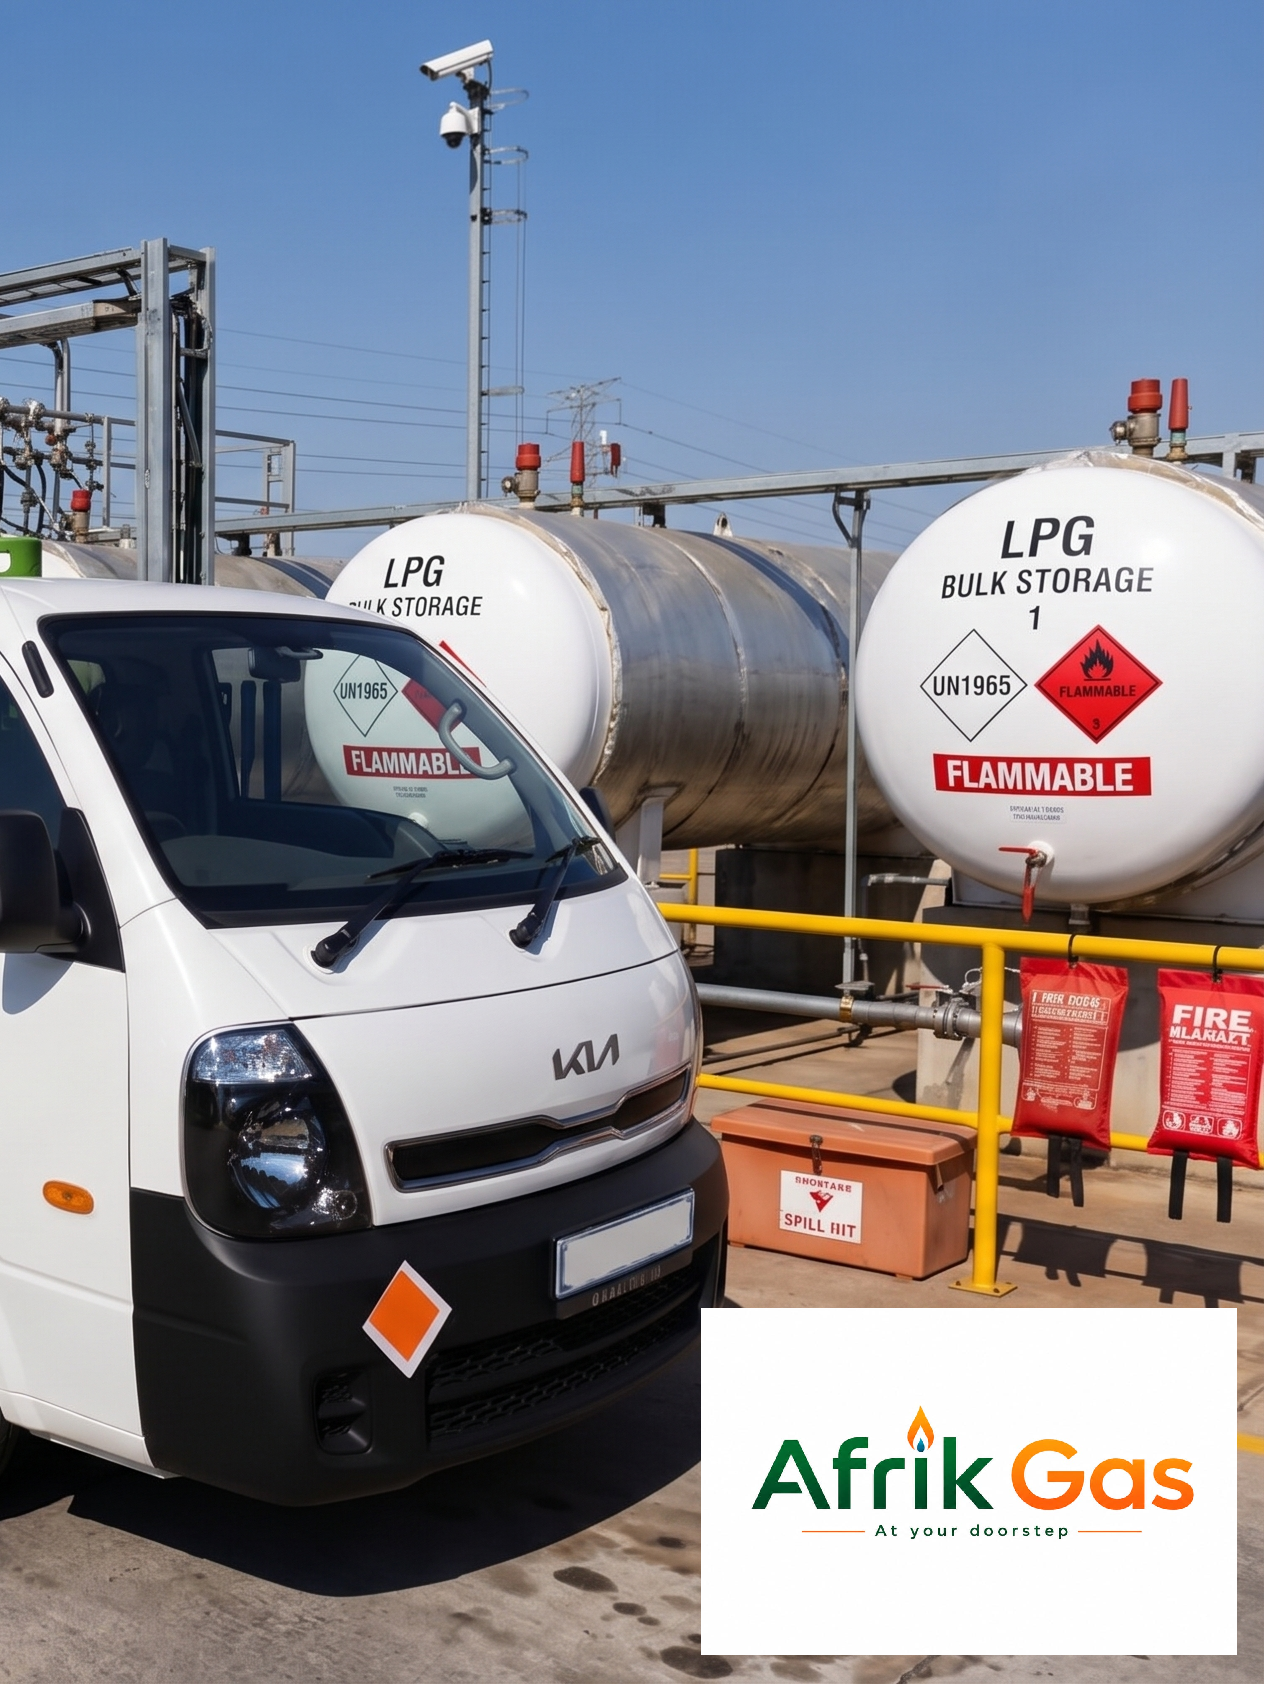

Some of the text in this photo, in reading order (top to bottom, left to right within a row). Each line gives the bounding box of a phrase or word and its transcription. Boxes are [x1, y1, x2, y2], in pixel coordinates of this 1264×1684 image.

[1000, 515, 1095, 559] LPG
[384, 555, 445, 588] LPG
[941, 566, 1154, 599] BULK STORAGE
[391, 596, 483, 617] STORAGE
[1028, 605, 1041, 630] 1
[340, 682, 388, 700] UN1965
[932, 674, 1011, 697] UN1965
[1059, 685, 1136, 698] FLAMMABLE
[946, 759, 1134, 792] FLAMMABLE
[1172, 1004, 1252, 1033] FIRE
[552, 1033, 620, 1081] KIA
[784, 1213, 825, 1233] SPILL
